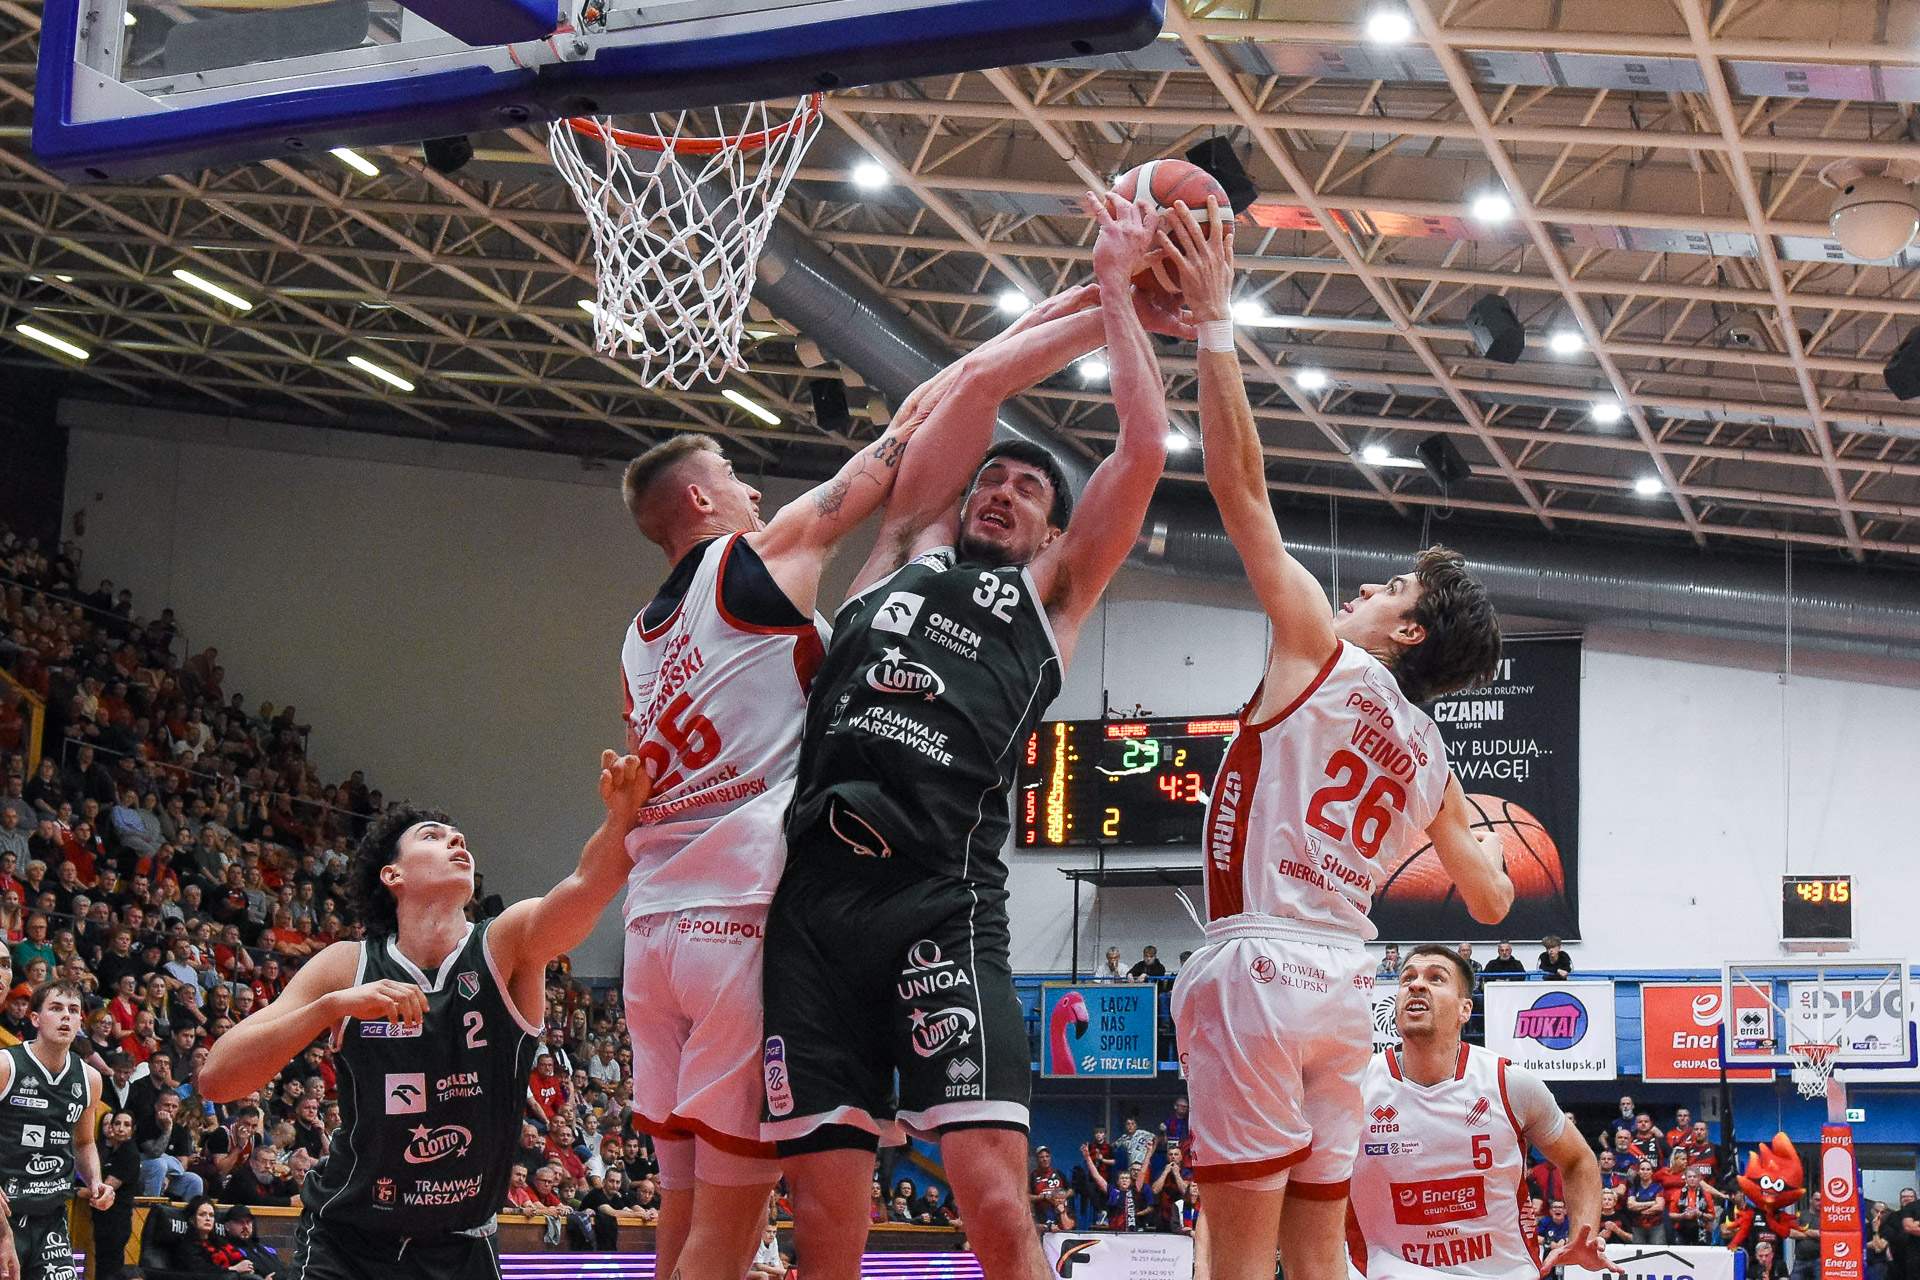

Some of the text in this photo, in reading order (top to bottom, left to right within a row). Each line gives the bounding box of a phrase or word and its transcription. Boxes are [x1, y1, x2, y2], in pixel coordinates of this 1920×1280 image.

[973, 571, 1020, 624] 32
[929, 613, 981, 648] ORLEN
[924, 626, 978, 662] TERMIKA
[883, 664, 932, 689] LOTTO
[1495, 684, 1535, 695] DRUŻYNY
[1434, 700, 1504, 722] CZARNI
[865, 706, 948, 748] TRAMWAJE
[848, 716, 953, 766] WARSZAWSKIE
[1473, 739, 1553, 757] BUDUJĄ...
[1123, 740, 1187, 768] 23 2
[719, 776, 768, 803] SŁUPSK
[1305, 749, 1407, 859] 26
[1103, 808, 1120, 836] 2
[1279, 859, 1324, 891] ENERGA
[1321, 854, 1372, 891] Słupsk
[692, 921, 763, 938] POLIPOL
[1282, 963, 1326, 980] POWIAT
[897, 968, 970, 1000] UNIQA
[1281, 975, 1328, 993] SŁUPSKI
[362, 1026, 383, 1034] PGE
[463, 1011, 488, 1049] 2
[922, 1015, 958, 1048] LOTTO
[1101, 1016, 1125, 1031] NAS
[1513, 1012, 1578, 1038] DUKAT
[1740, 1027, 1765, 1036] errea
[1101, 1035, 1139, 1051] SPORT
[1673, 1032, 1719, 1049] Ener
[1101, 1058, 1123, 1070] TRZY
[1524, 1059, 1606, 1071] dukatslupsk.pl
[1673, 1060, 1708, 1069] GRUPA
[437, 1086, 483, 1102] TERMIKA
[945, 1083, 980, 1097] errea
[66, 1103, 84, 1123] 30
[1370, 1123, 1400, 1134] errea
[418, 1132, 458, 1157] LOTTO
[1367, 1146, 1386, 1154] PGE
[1471, 1134, 1493, 1170] 5
[1648, 1143, 1656, 1151] 2
[33, 1160, 58, 1171] LOTTO
[415, 1173, 482, 1193] TRAMWAJ
[1047, 1179, 1060, 1187] 29
[1422, 1186, 1476, 1203] Energa
[1823, 1205, 1856, 1217] włącza
[1828, 1213, 1851, 1222] sport
[1401, 1233, 1492, 1268] CZARNI
[1825, 1259, 1857, 1272] Energa
